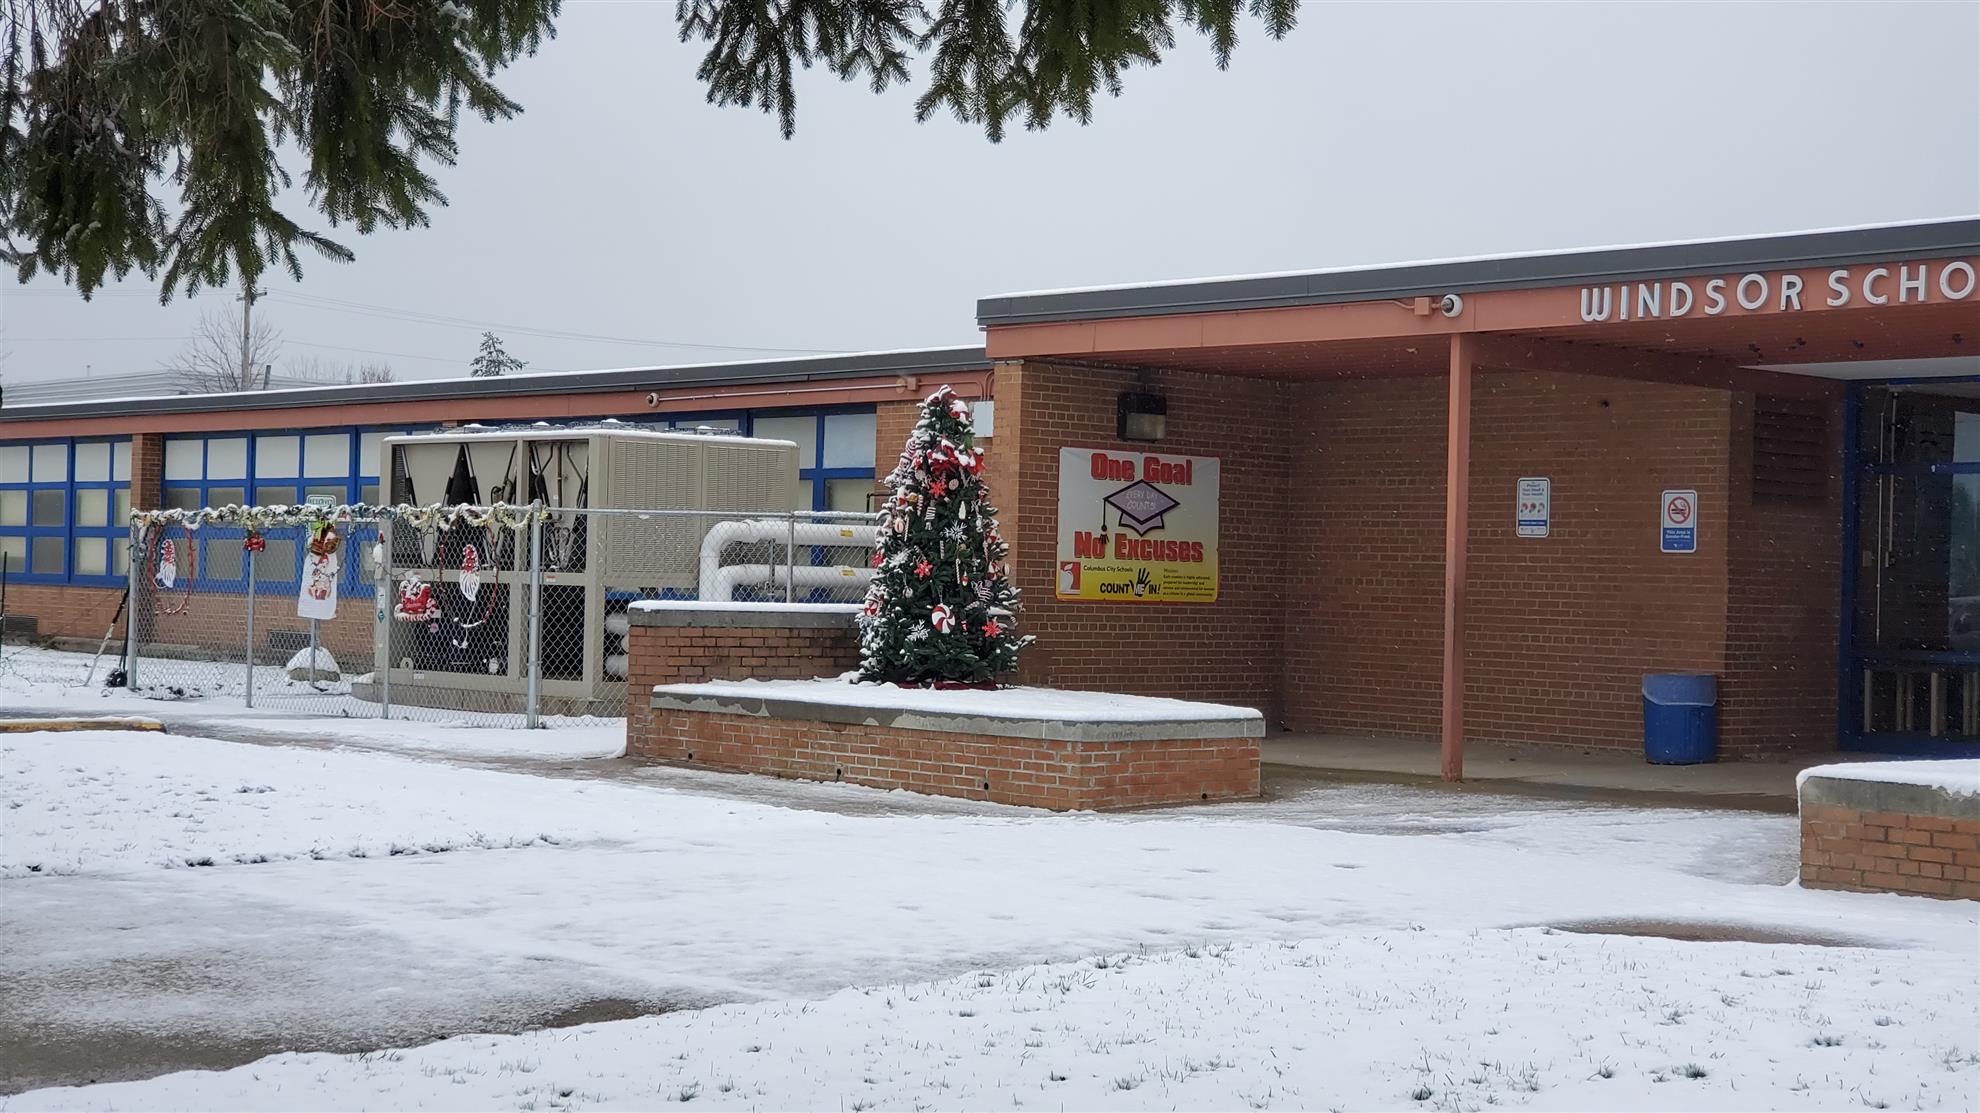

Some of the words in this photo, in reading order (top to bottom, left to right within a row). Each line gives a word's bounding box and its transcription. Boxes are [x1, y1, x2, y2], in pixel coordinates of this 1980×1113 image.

[1580, 273, 1804, 322] WINDSOR
[1826, 261, 1976, 307] SCHO
[1091, 453, 1135, 481] One
[1143, 456, 1192, 485] Goal
[1074, 531, 1106, 559] No
[1114, 533, 1203, 562] Excuses
[1100, 583, 1130, 594] COUNT
[1149, 583, 1161, 594] IN!
